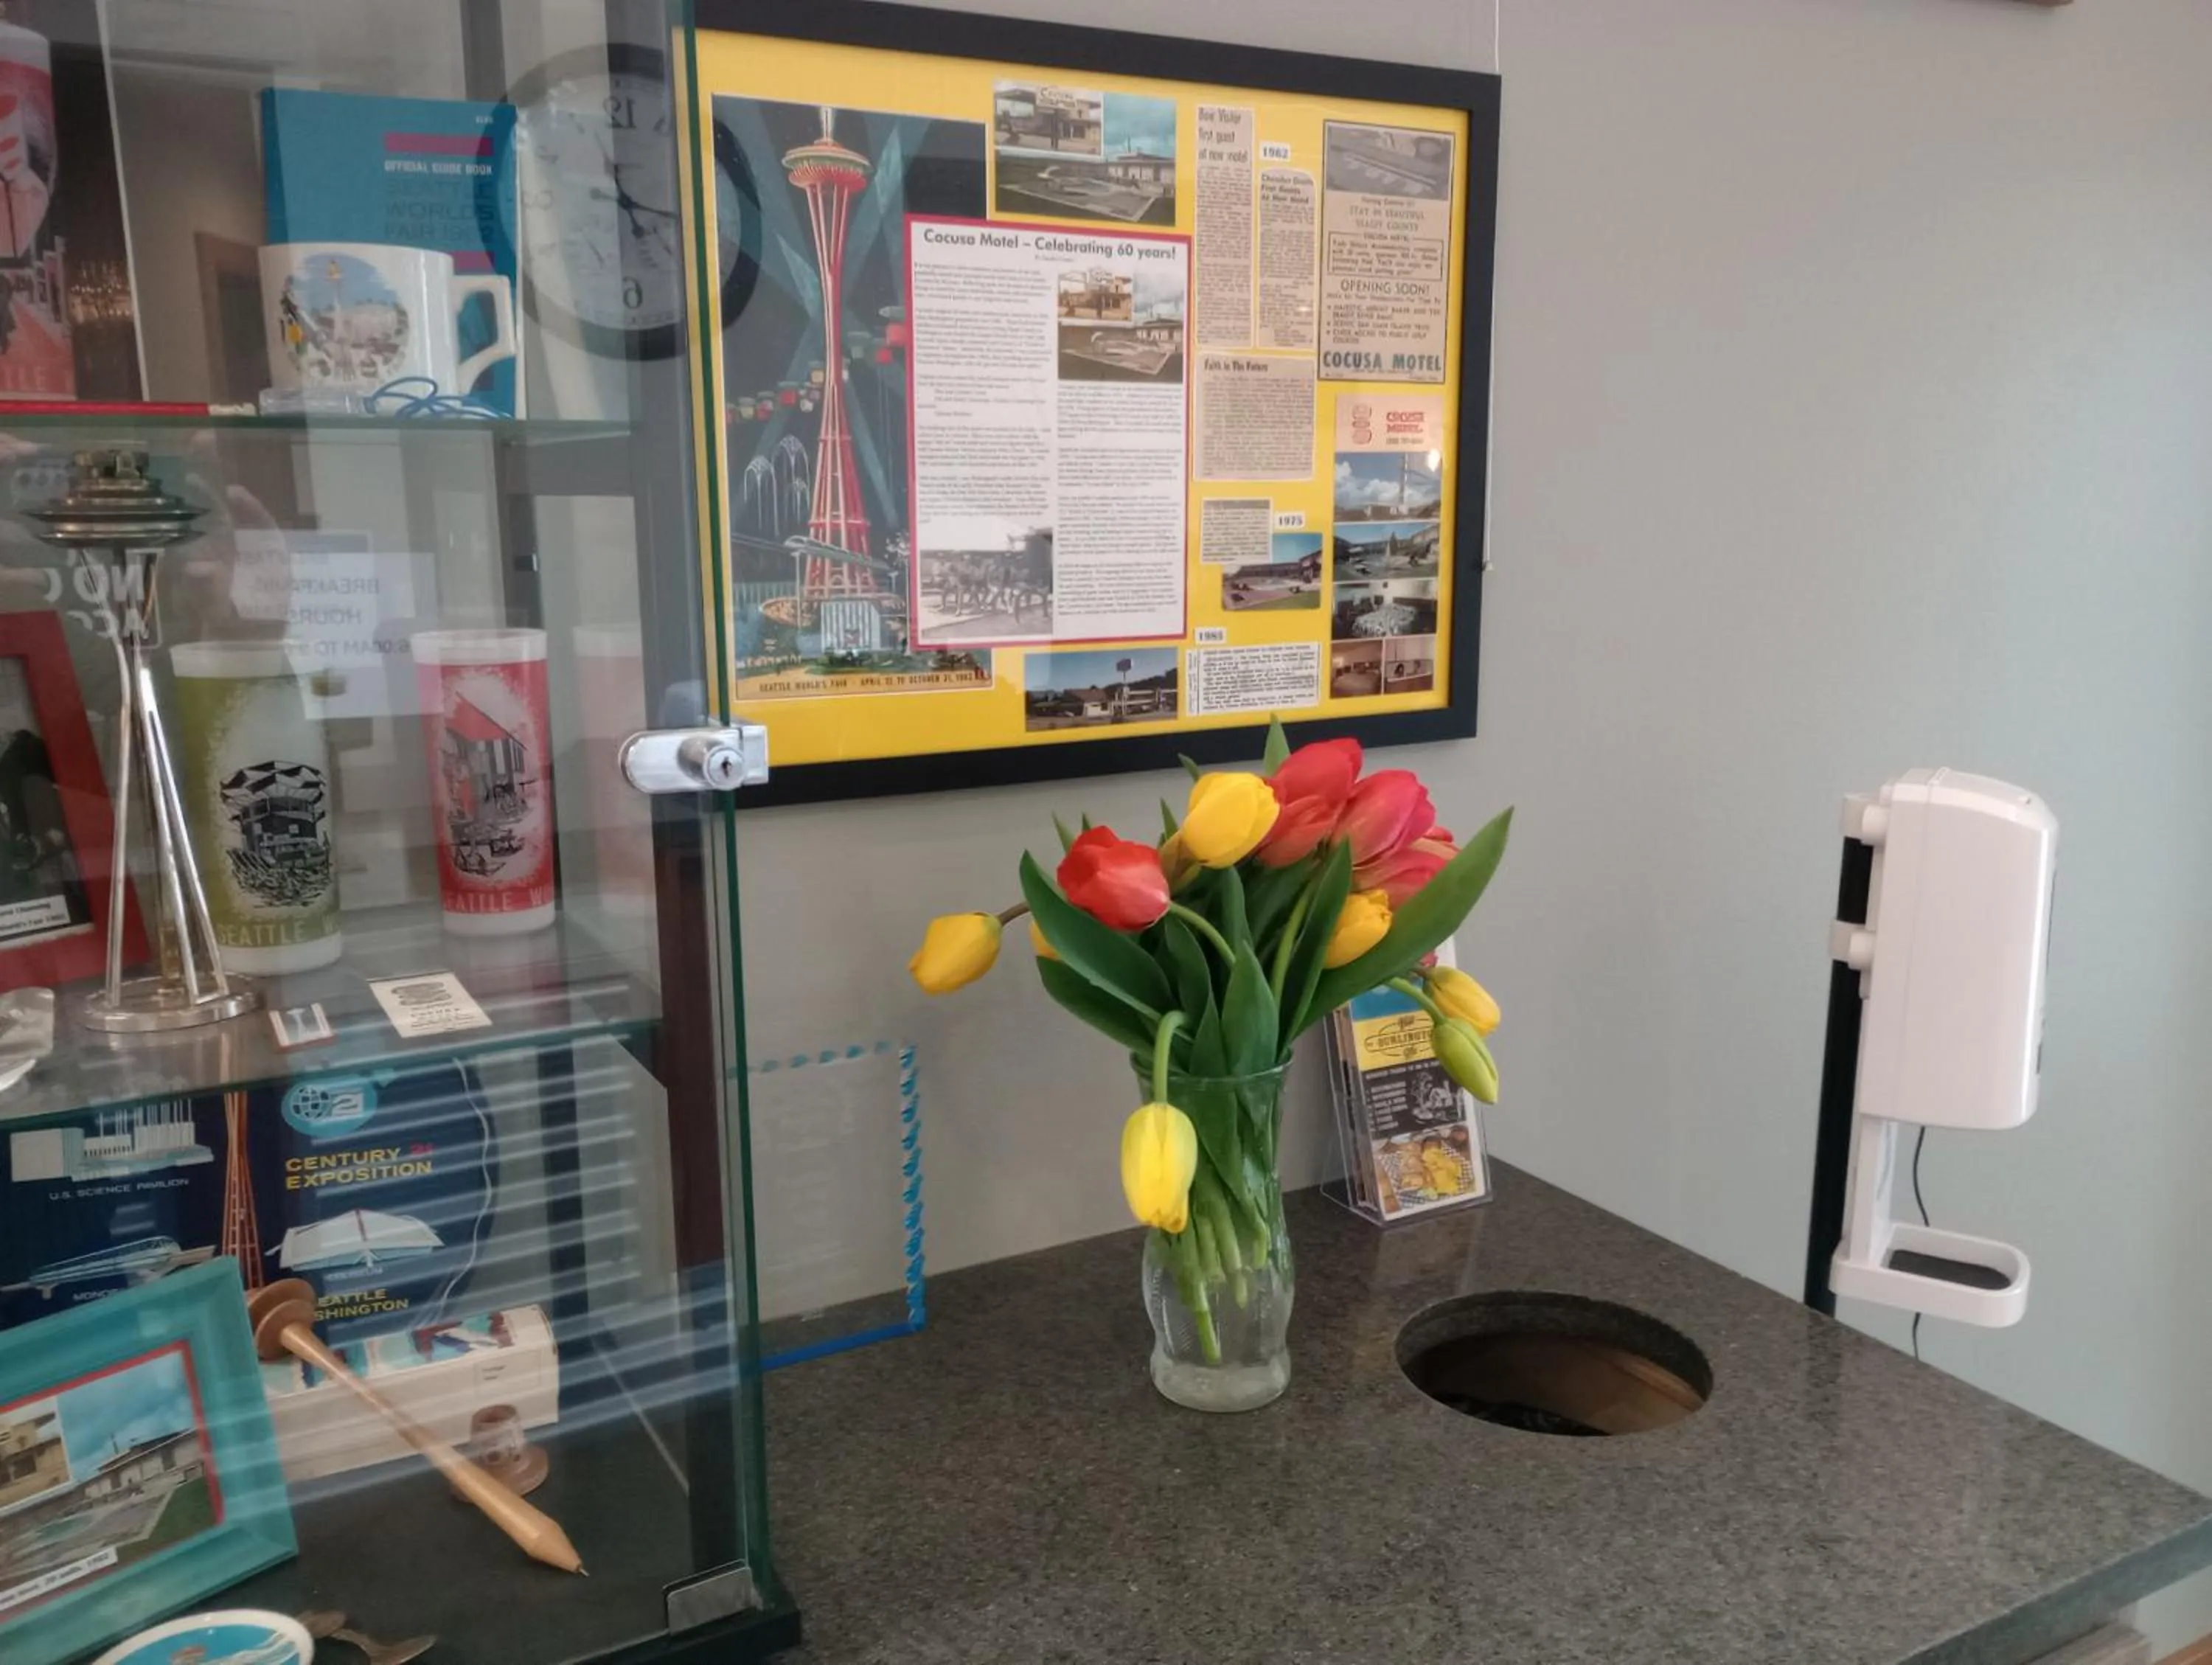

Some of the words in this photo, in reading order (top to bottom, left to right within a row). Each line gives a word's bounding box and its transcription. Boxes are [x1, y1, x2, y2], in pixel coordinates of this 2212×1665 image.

[465, 164, 493, 175] BOOK
[924, 228, 975, 246] Cocusa
[980, 232, 1019, 248] Motel
[1034, 236, 1113, 258] Celebrating
[1117, 243, 1134, 257] 60
[1138, 246, 1176, 260] years!
[1340, 278, 1392, 295] OPENING
[1394, 282, 1430, 296] SOON!
[1323, 351, 1382, 369] COCUSA
[1392, 354, 1441, 371] MOTEL
[1279, 515, 1304, 526] 1975
[217, 921, 308, 945] SEATTLE
[285, 1147, 402, 1172] CENTURY
[285, 1160, 434, 1190] EXPOSITION
[77, 1184, 131, 1198] SCIENCE
[136, 1178, 189, 1191] PAVILION
[317, 1289, 386, 1308] EATTLE
[314, 1299, 409, 1321] SHINGTON
